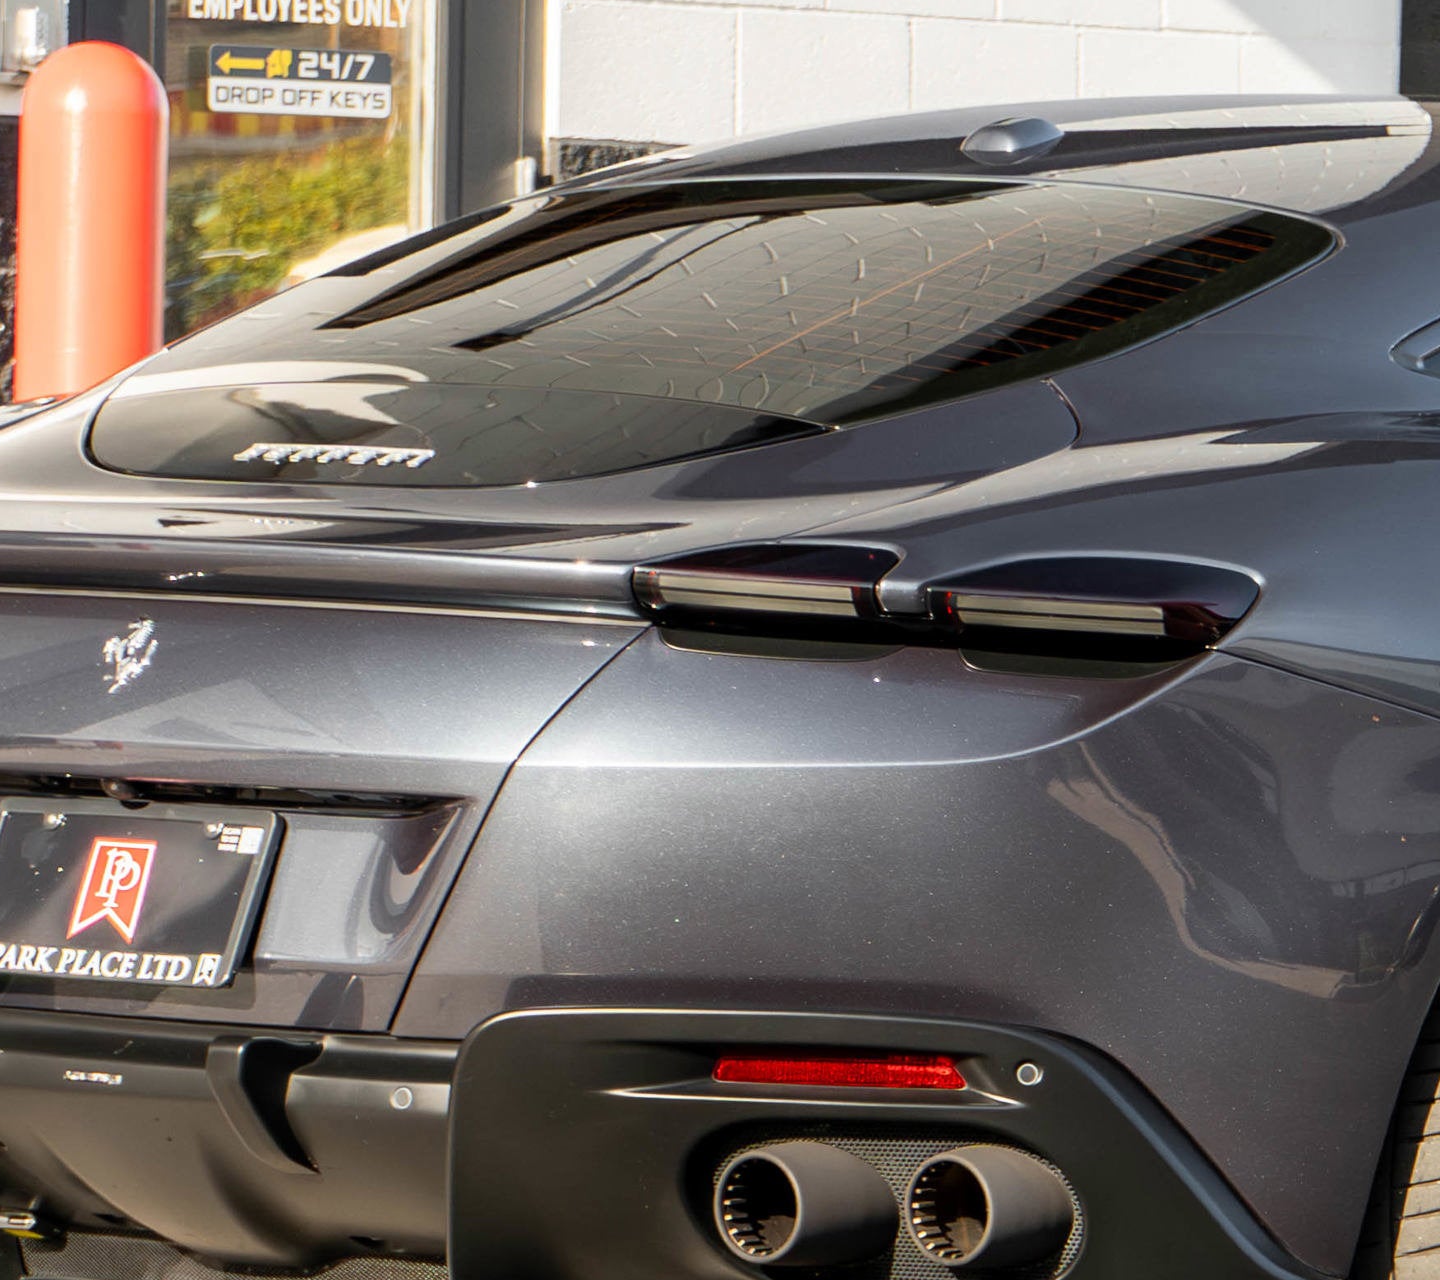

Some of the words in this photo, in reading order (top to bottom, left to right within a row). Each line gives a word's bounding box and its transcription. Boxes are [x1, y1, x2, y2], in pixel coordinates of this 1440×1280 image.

[297, 51, 376, 81] 24/7
[215, 84, 274, 106] DROP
[282, 87, 322, 108] OFF
[329, 90, 386, 110] KEYS
[55, 947, 138, 978] PLACE
[136, 953, 192, 982] LTD
